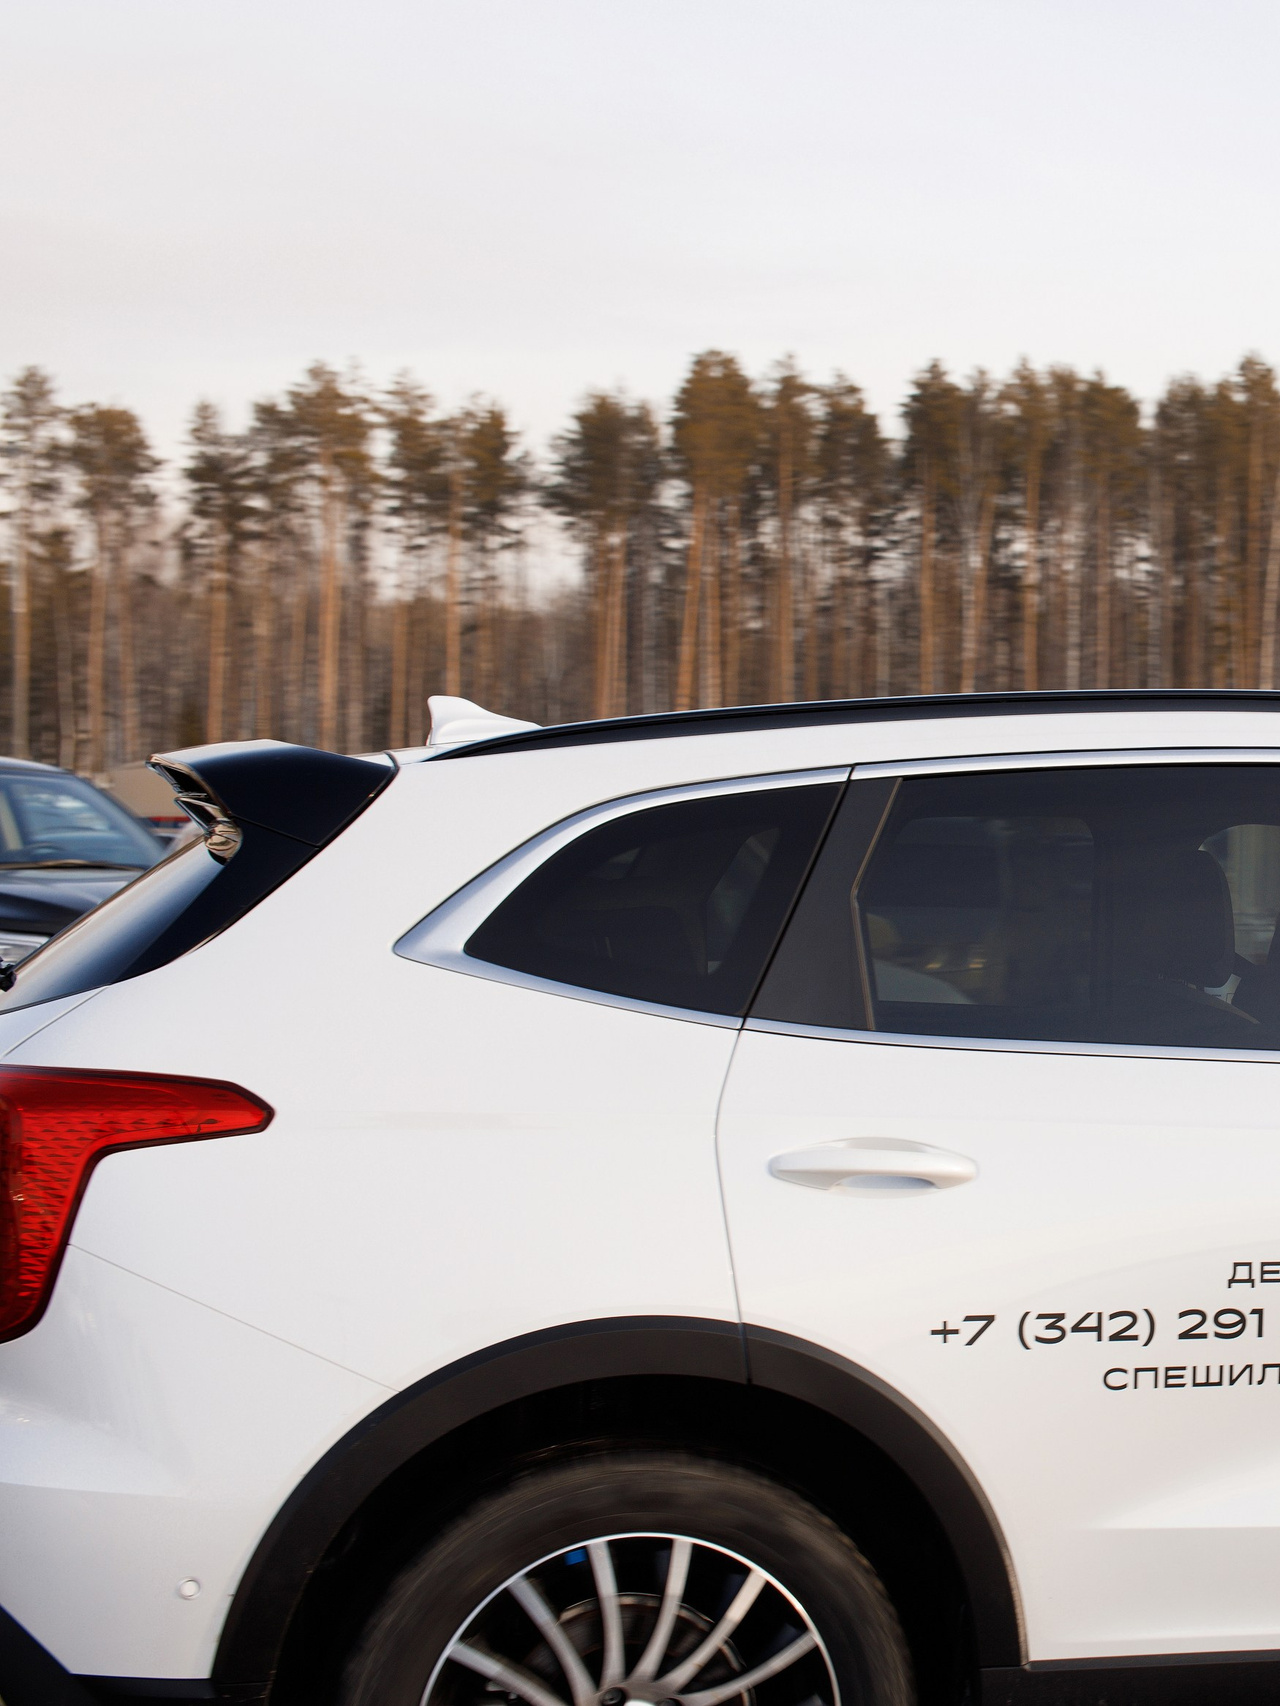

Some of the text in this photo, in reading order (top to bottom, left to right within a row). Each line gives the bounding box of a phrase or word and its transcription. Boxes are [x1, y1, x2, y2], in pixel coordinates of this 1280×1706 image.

[929, 1314, 996, 1347] +7
[1017, 1308, 1156, 1350] (342)
[1177, 1308, 1265, 1341] 291
